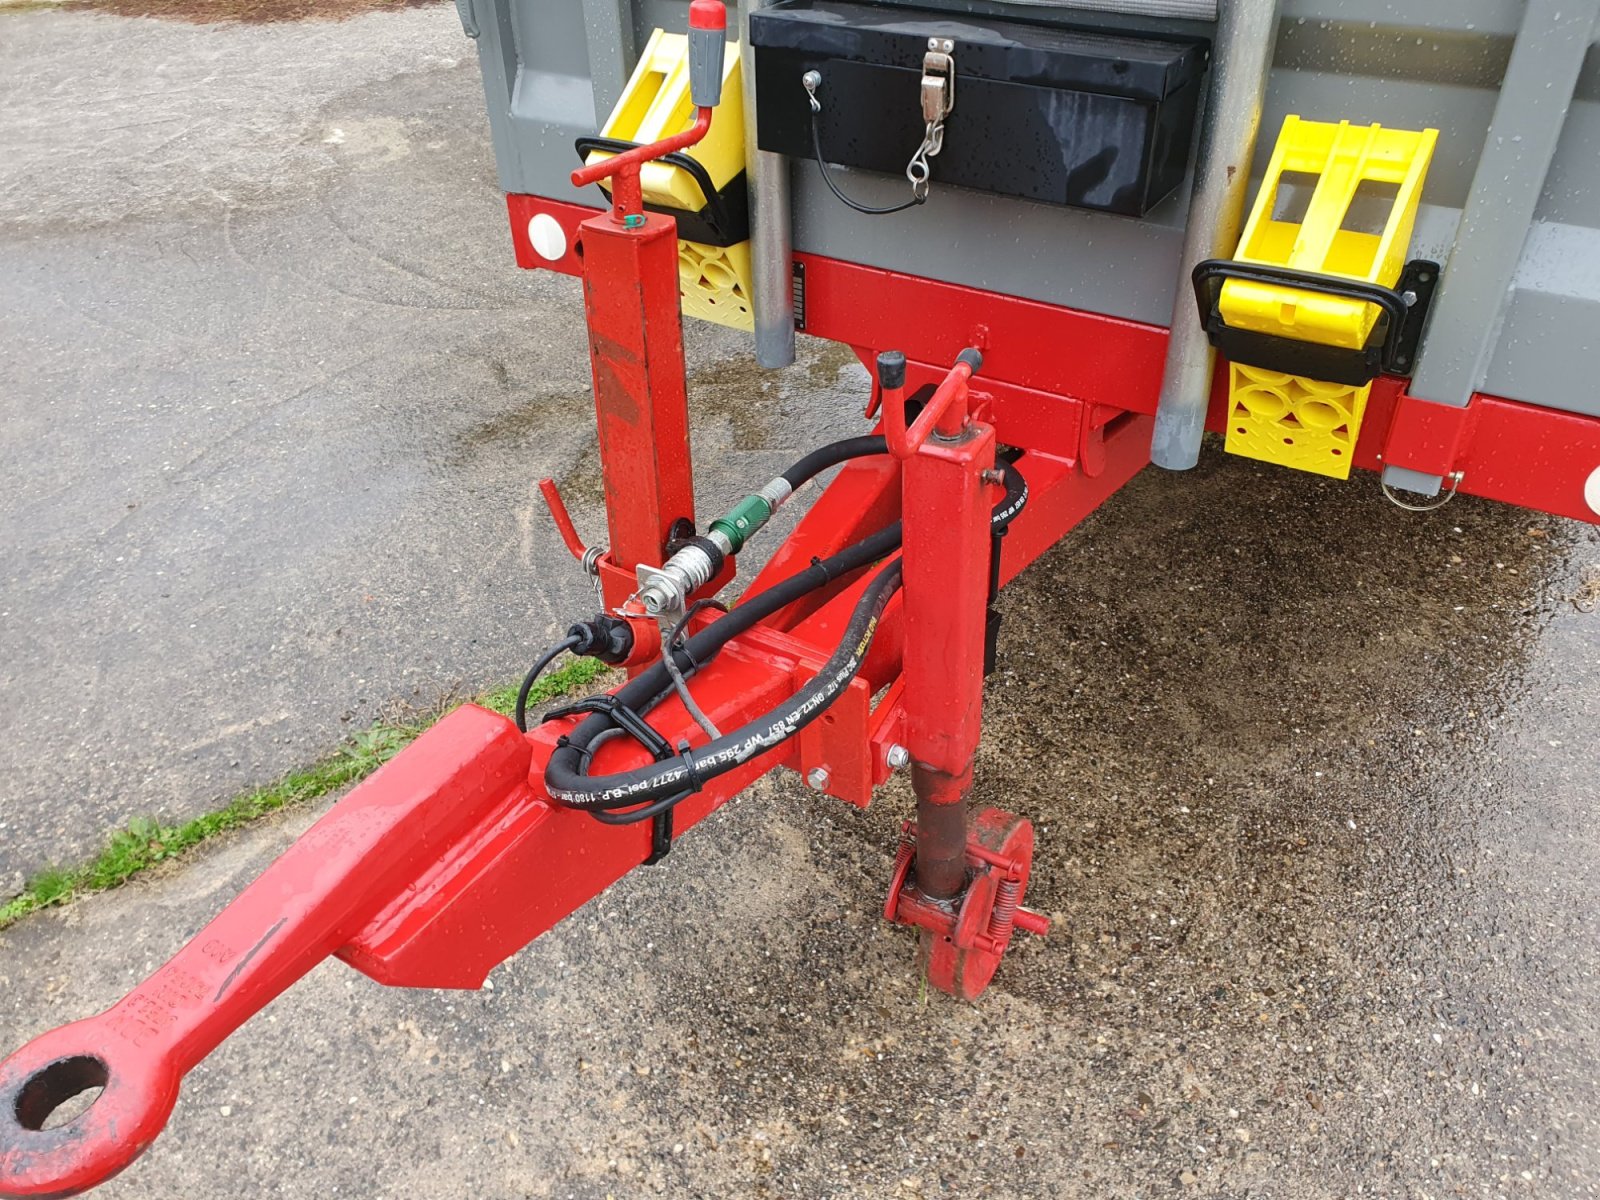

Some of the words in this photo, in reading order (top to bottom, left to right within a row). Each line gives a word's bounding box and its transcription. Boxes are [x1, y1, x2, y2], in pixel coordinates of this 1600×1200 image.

[836, 667, 850, 683] Plus
[768, 720, 785, 737] 857
[744, 733, 765, 750] WP
[718, 744, 741, 762] 295
[695, 756, 717, 771] bar
[653, 770, 682, 788] 4277
[628, 780, 648, 795] psi
[575, 793, 595, 803] 1180
